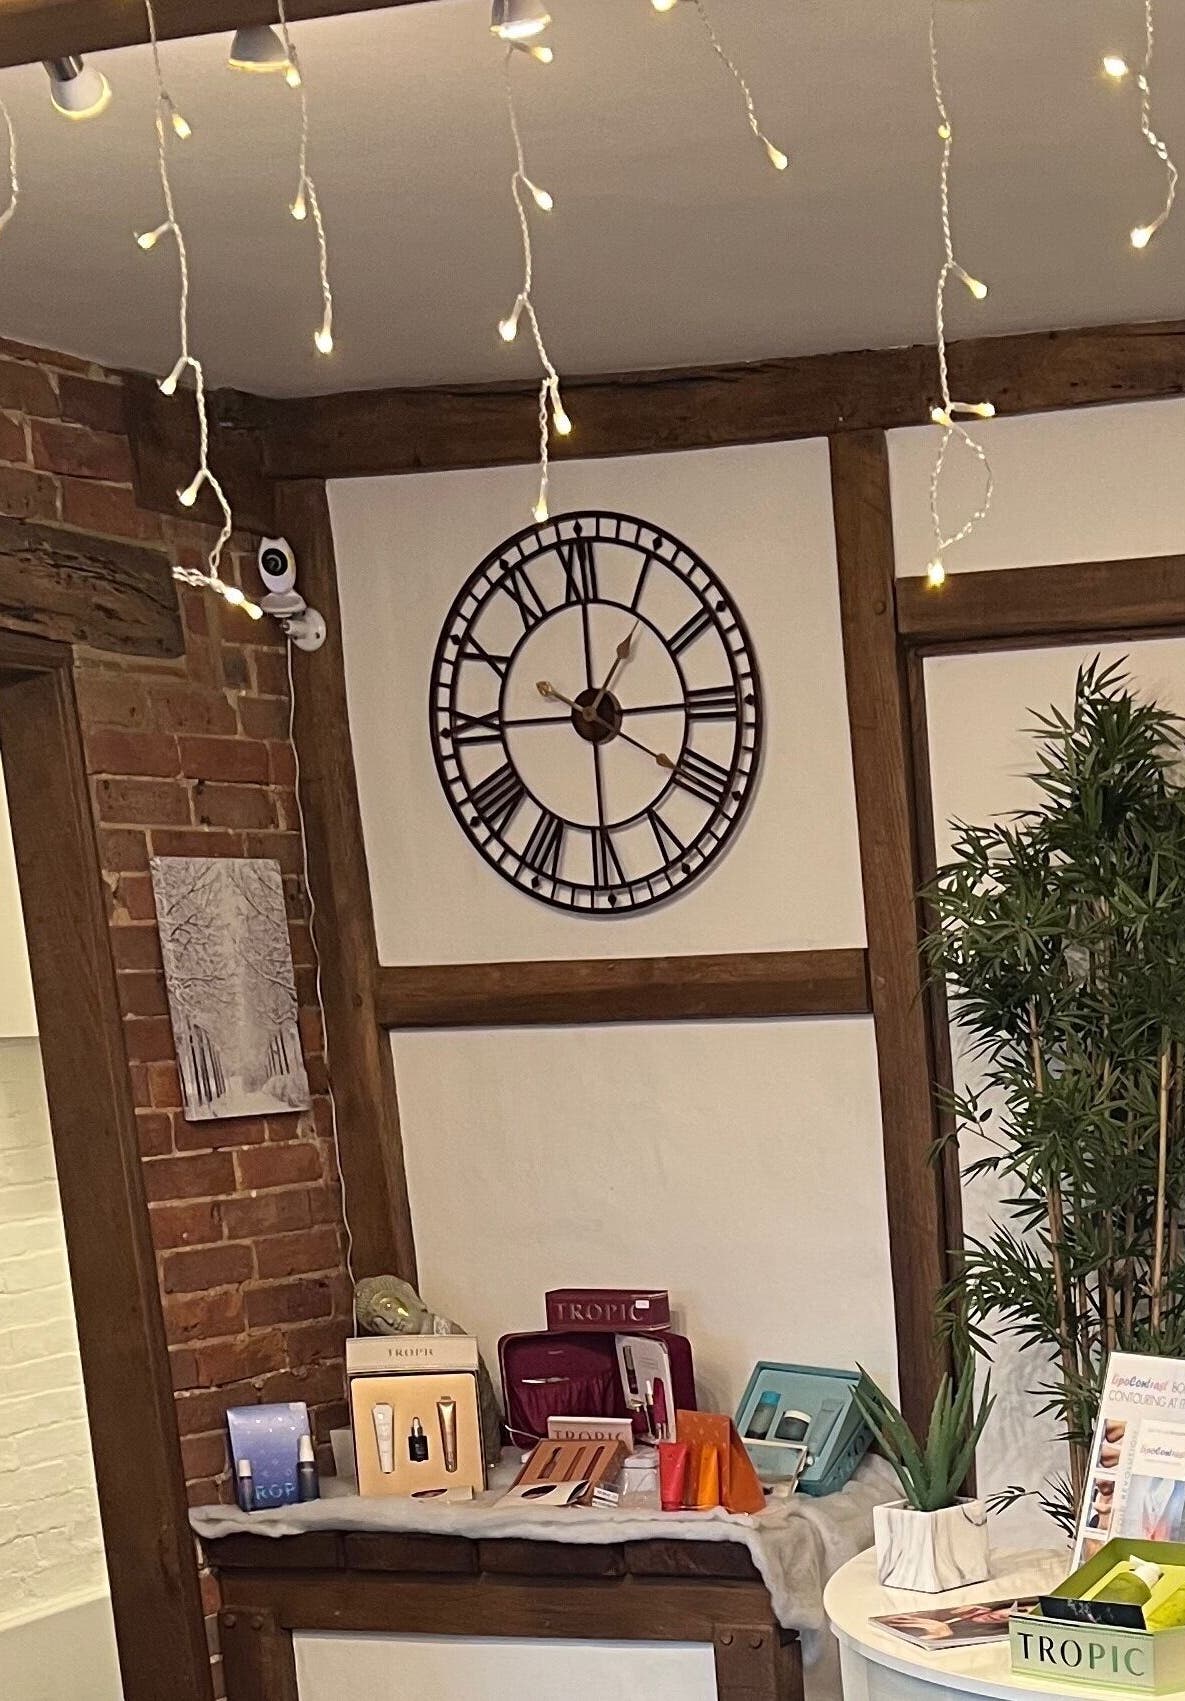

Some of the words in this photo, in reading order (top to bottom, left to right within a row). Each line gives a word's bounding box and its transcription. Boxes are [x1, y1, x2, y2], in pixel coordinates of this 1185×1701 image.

[552, 1301, 645, 1321] TROPIC
[1108, 1390, 1167, 1408] CONTOURING
[1016, 1631, 1145, 1677] TROPIC
